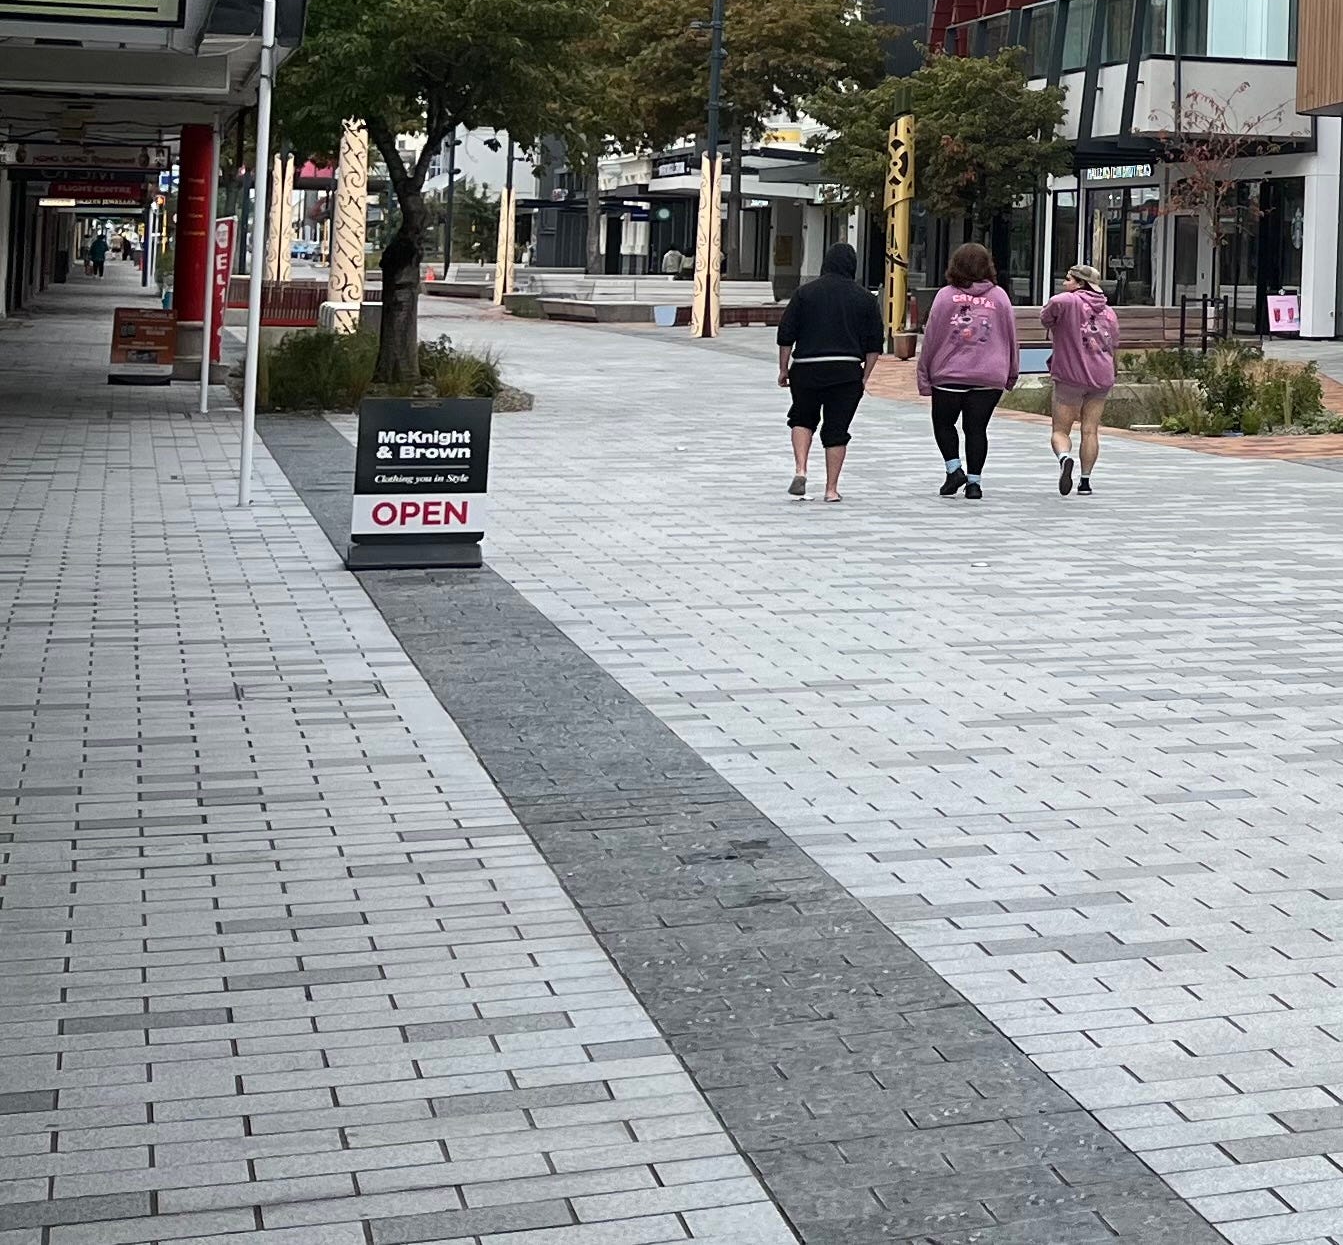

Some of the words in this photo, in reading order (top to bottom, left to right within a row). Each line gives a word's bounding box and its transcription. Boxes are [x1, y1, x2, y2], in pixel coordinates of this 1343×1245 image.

[952, 294, 996, 310] CRYSTAL
[377, 430, 471, 445] McKnight
[376, 446, 393, 459] &
[399, 446, 471, 459] Brown
[374, 474, 413, 484] Clothing
[414, 475, 432, 484] you
[446, 474, 469, 484] Style
[371, 501, 468, 526] OPEN
